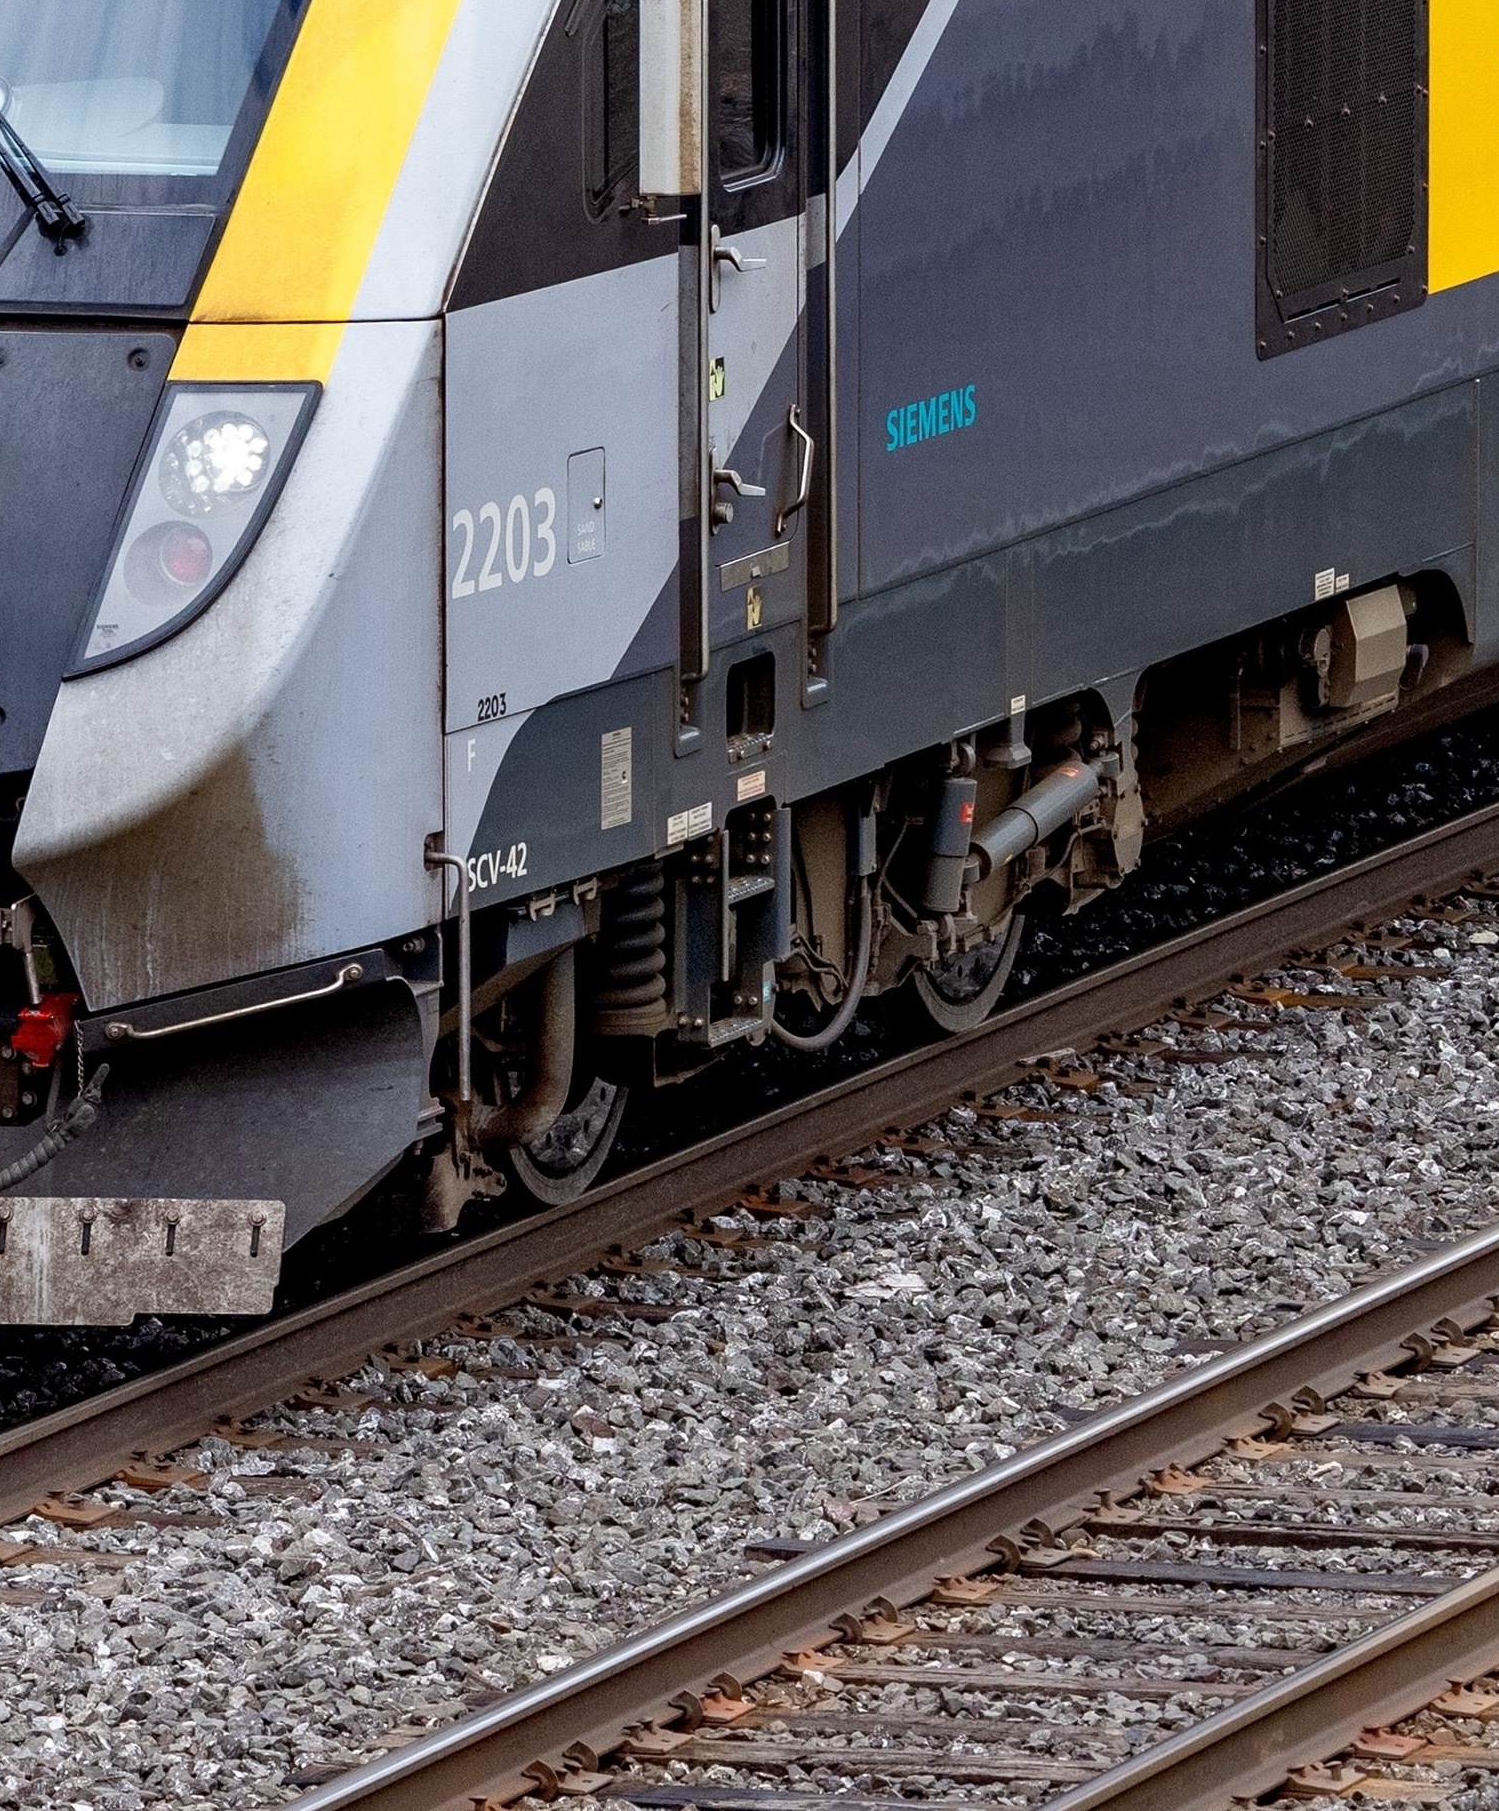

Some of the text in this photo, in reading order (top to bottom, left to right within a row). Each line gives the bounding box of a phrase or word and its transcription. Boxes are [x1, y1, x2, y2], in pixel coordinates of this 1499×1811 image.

[885, 384, 977, 452] SIEMENS
[451, 487, 556, 599] 2203
[577, 521, 595, 536] SAND
[477, 692, 507, 722] 2203
[467, 738, 476, 772] F
[466, 841, 528, 893] SCV-42
